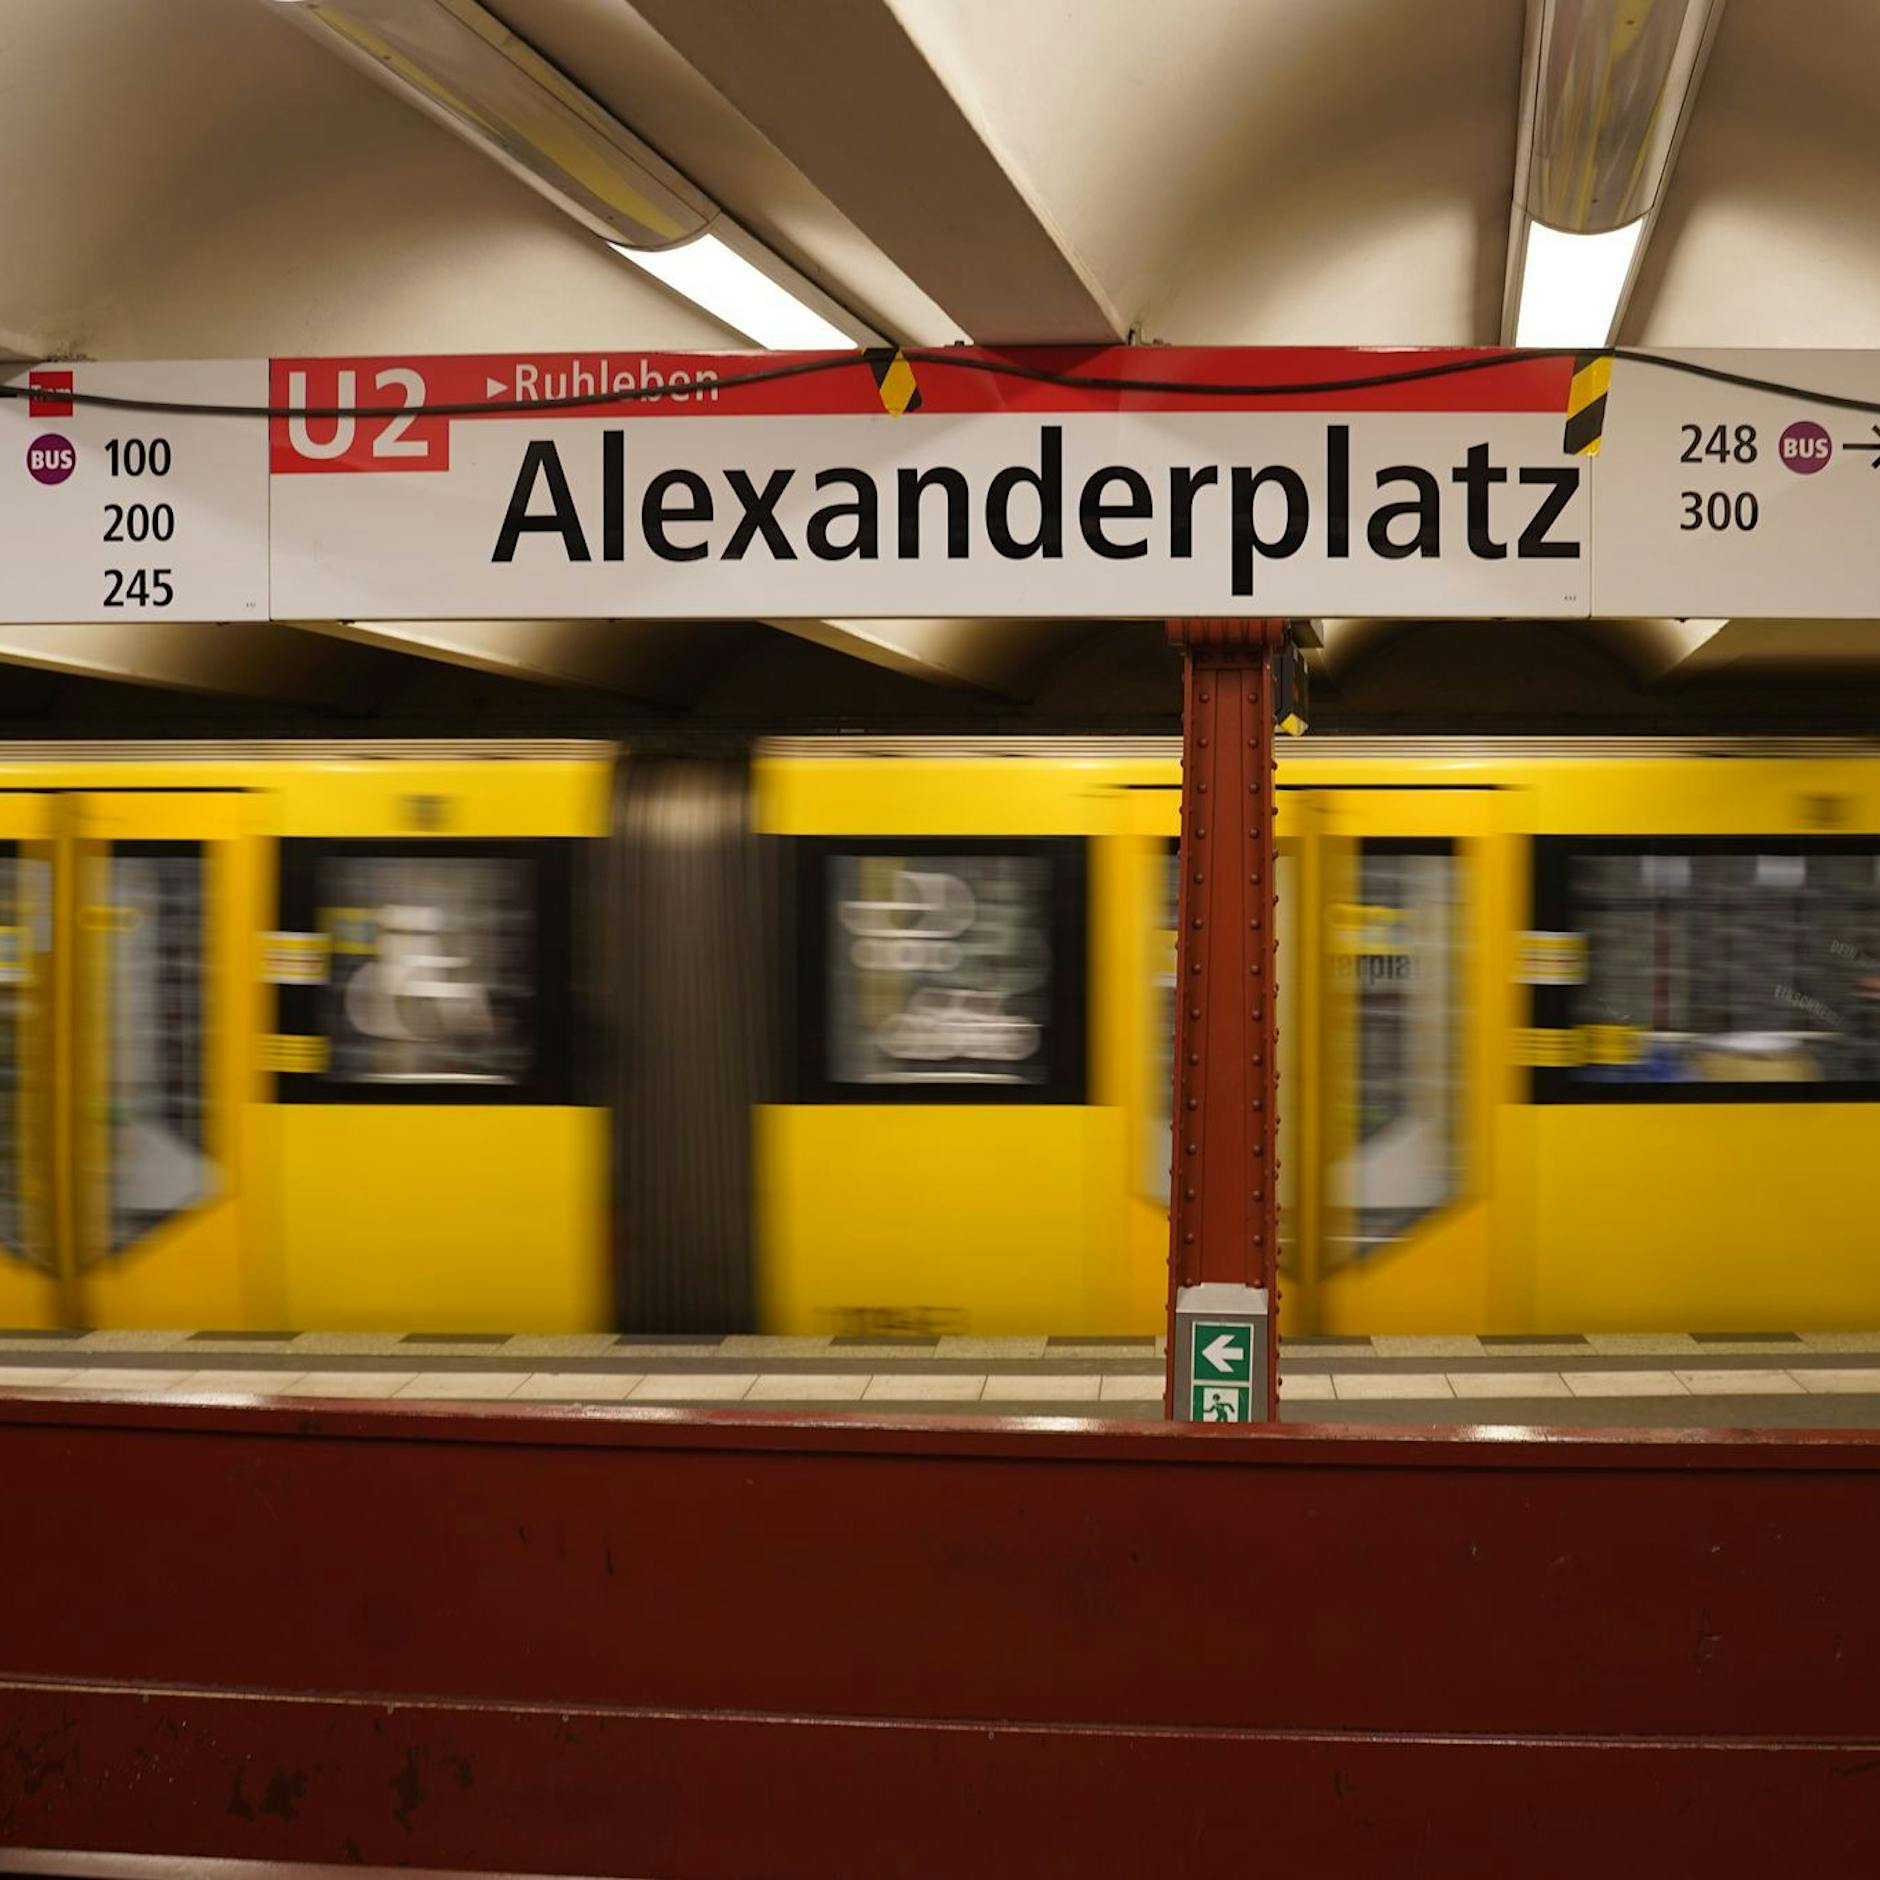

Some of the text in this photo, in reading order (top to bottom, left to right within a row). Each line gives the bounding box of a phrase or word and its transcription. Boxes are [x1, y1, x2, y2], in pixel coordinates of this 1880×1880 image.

[516, 360, 718, 402] Ruhleben
[288, 369, 430, 460] U2
[30, 438, 172, 477] BUS 100
[1681, 423, 1829, 464] 248 BUS
[104, 503, 175, 542] 200
[492, 422, 1581, 596] Alexanderplatz
[1681, 491, 1759, 532] 300
[104, 568, 174, 607] 245
